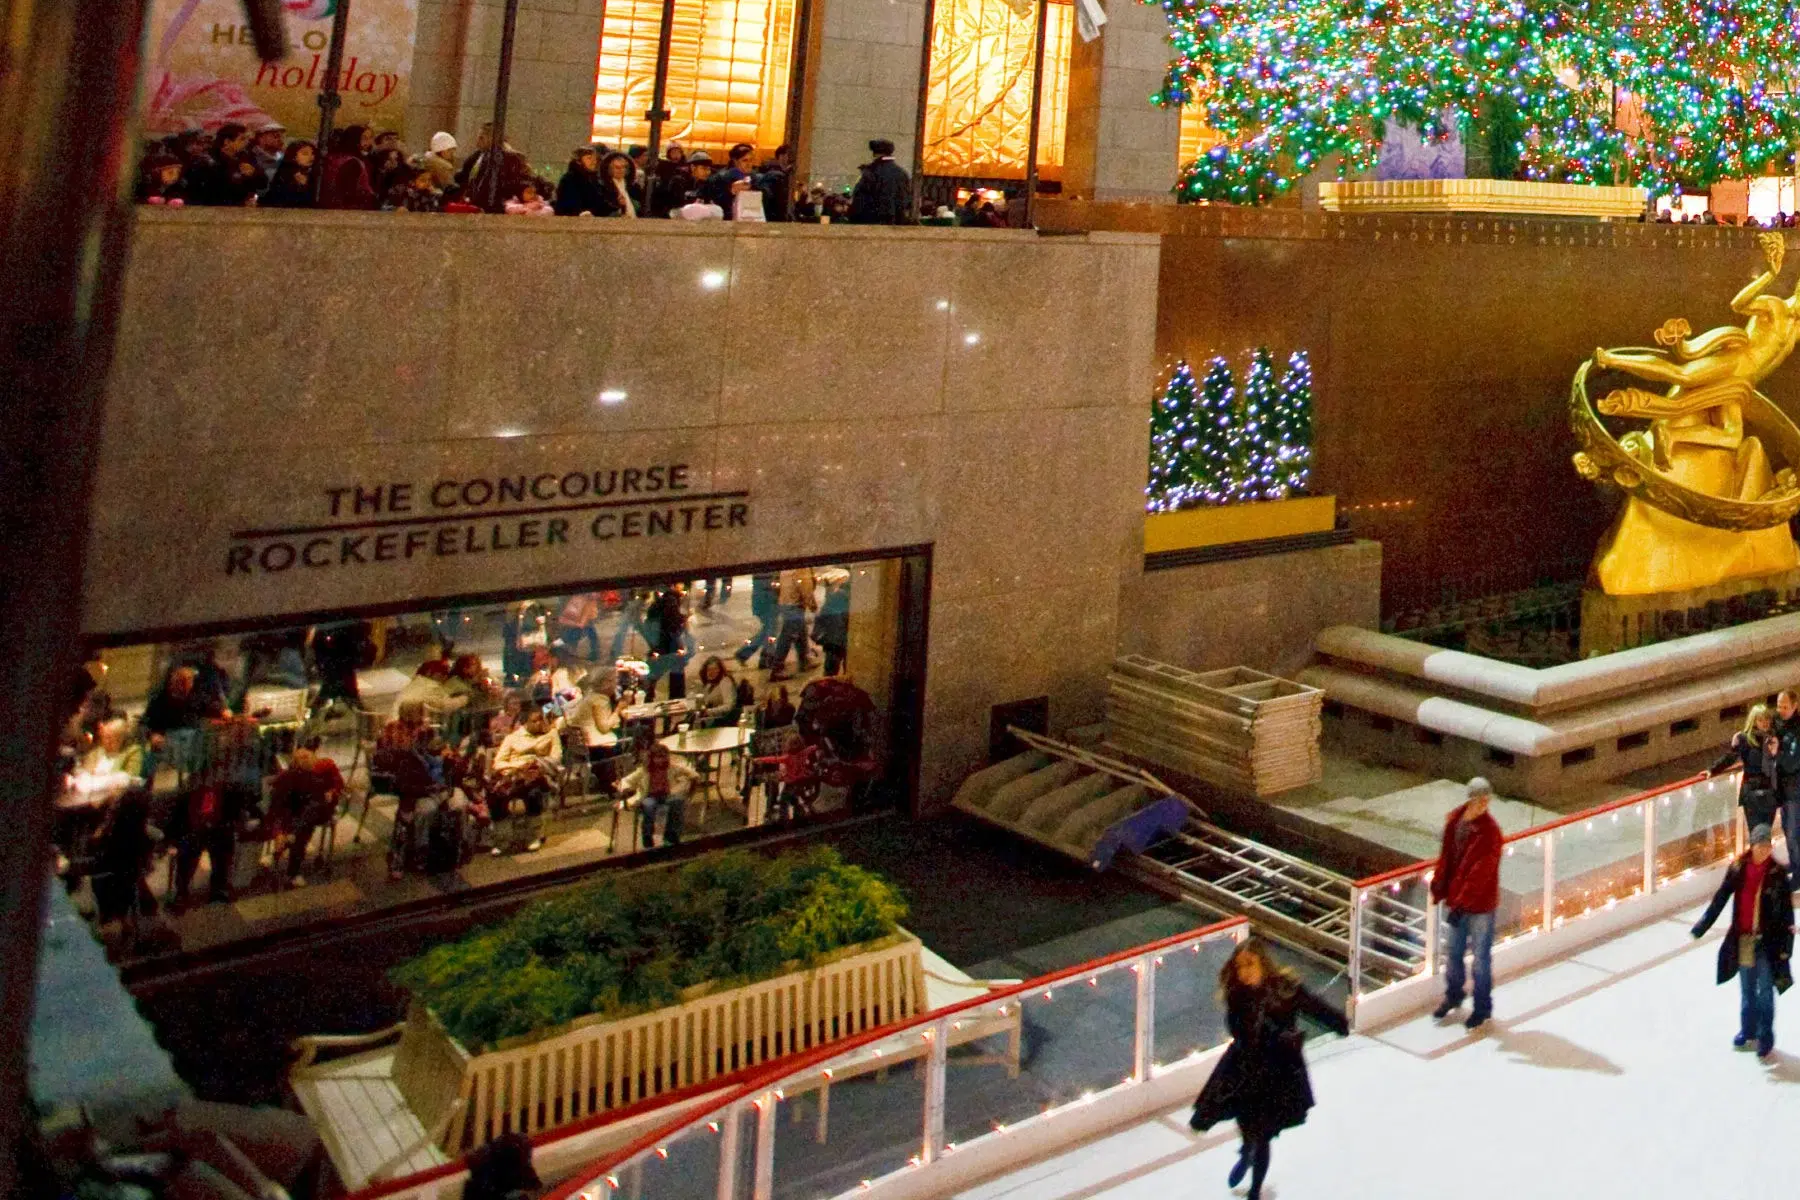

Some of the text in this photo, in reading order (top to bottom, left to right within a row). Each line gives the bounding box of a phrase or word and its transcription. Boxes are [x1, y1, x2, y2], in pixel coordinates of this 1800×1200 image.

[211, 22, 328, 51] HEO
[255, 53, 399, 108] holday
[325, 463, 689, 517] THE CONCOURSE
[225, 503, 749, 576] ROCKEFELLER CENTER
